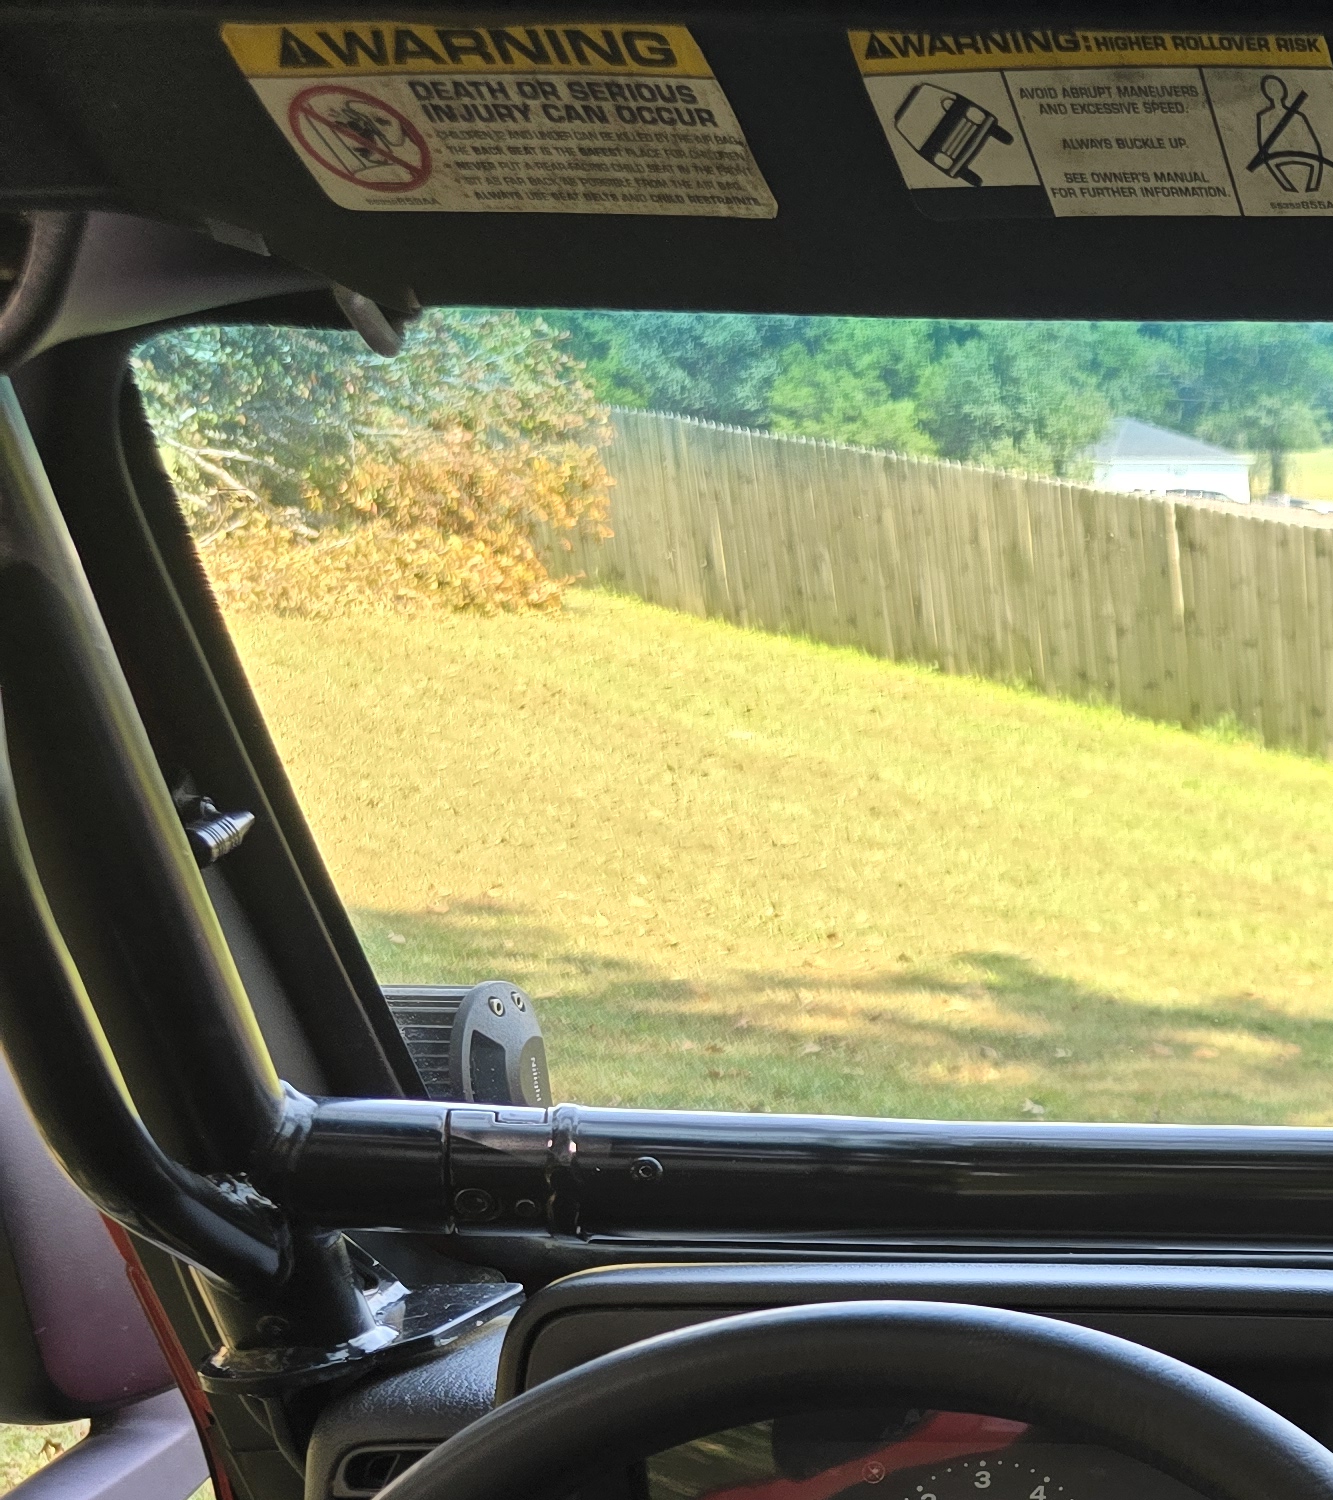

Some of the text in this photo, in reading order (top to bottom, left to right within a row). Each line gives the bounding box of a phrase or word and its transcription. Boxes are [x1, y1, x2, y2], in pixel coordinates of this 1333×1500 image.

[317, 28, 679, 68] WARNING
[1098, 37, 1166, 54] HIGHER
[1173, 35, 1269, 54] ROLLOVER
[1275, 35, 1322, 53] RISK
[409, 81, 697, 104] DEATH OR SERIOUS
[1019, 85, 1198, 100] AVOID ABRUPT MANEUVERS
[424, 103, 717, 128] INJURY CAN OCCUR
[1039, 102, 1067, 116] AND
[1071, 101, 1139, 116] EXCESSIVE
[1062, 138, 1112, 150] ALWAYS
[1116, 138, 1166, 150] BUCKLE
[1064, 172, 1209, 184] SEE OWNER'S MANUAL
[1051, 187, 1077, 199] FOR
[1080, 187, 1138, 199] FURTHER
[974, 1470, 992, 1489] 3
